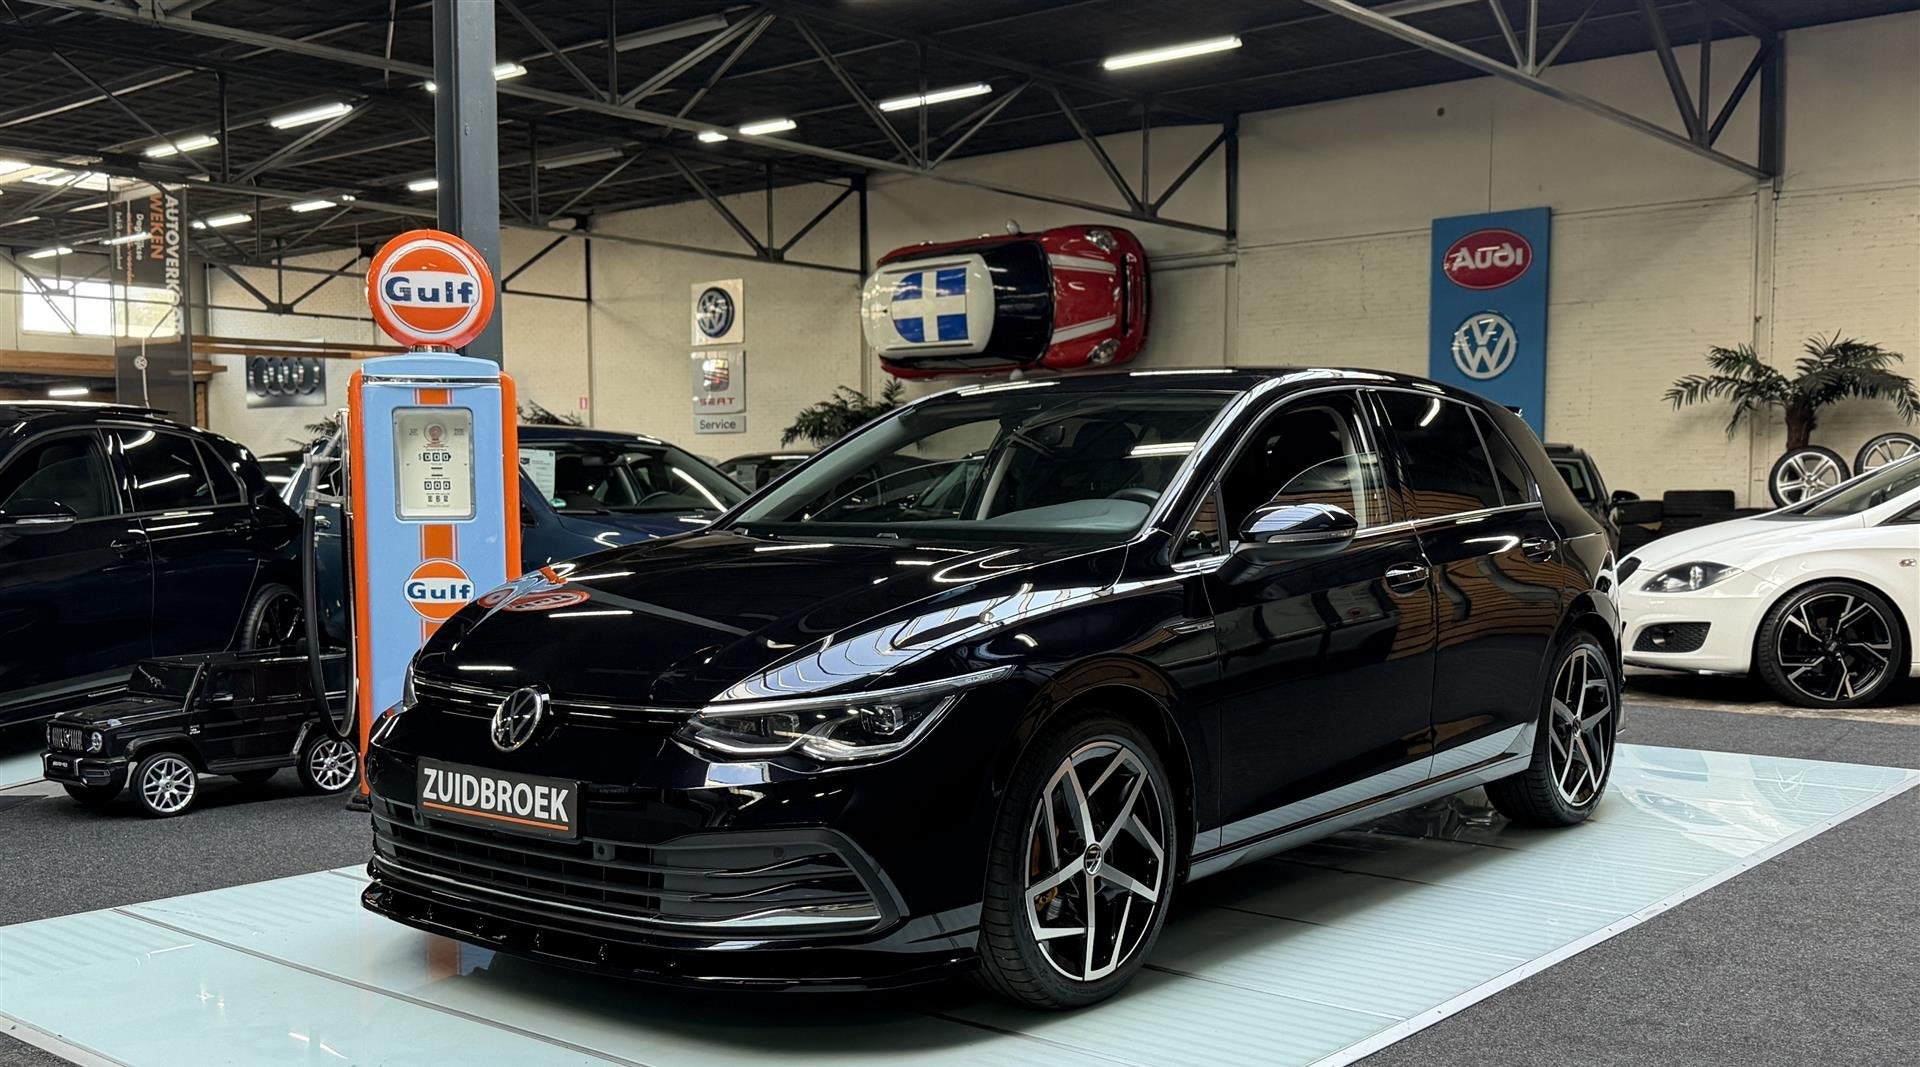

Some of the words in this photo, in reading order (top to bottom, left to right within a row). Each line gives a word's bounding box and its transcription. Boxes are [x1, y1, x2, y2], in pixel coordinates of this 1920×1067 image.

[150, 194, 164, 260] WEKEN
[385, 276, 473, 304] Gulf
[700, 419, 736, 430] Service
[407, 582, 470, 600] Gulf
[423, 768, 569, 822] ZUIDBROEK
